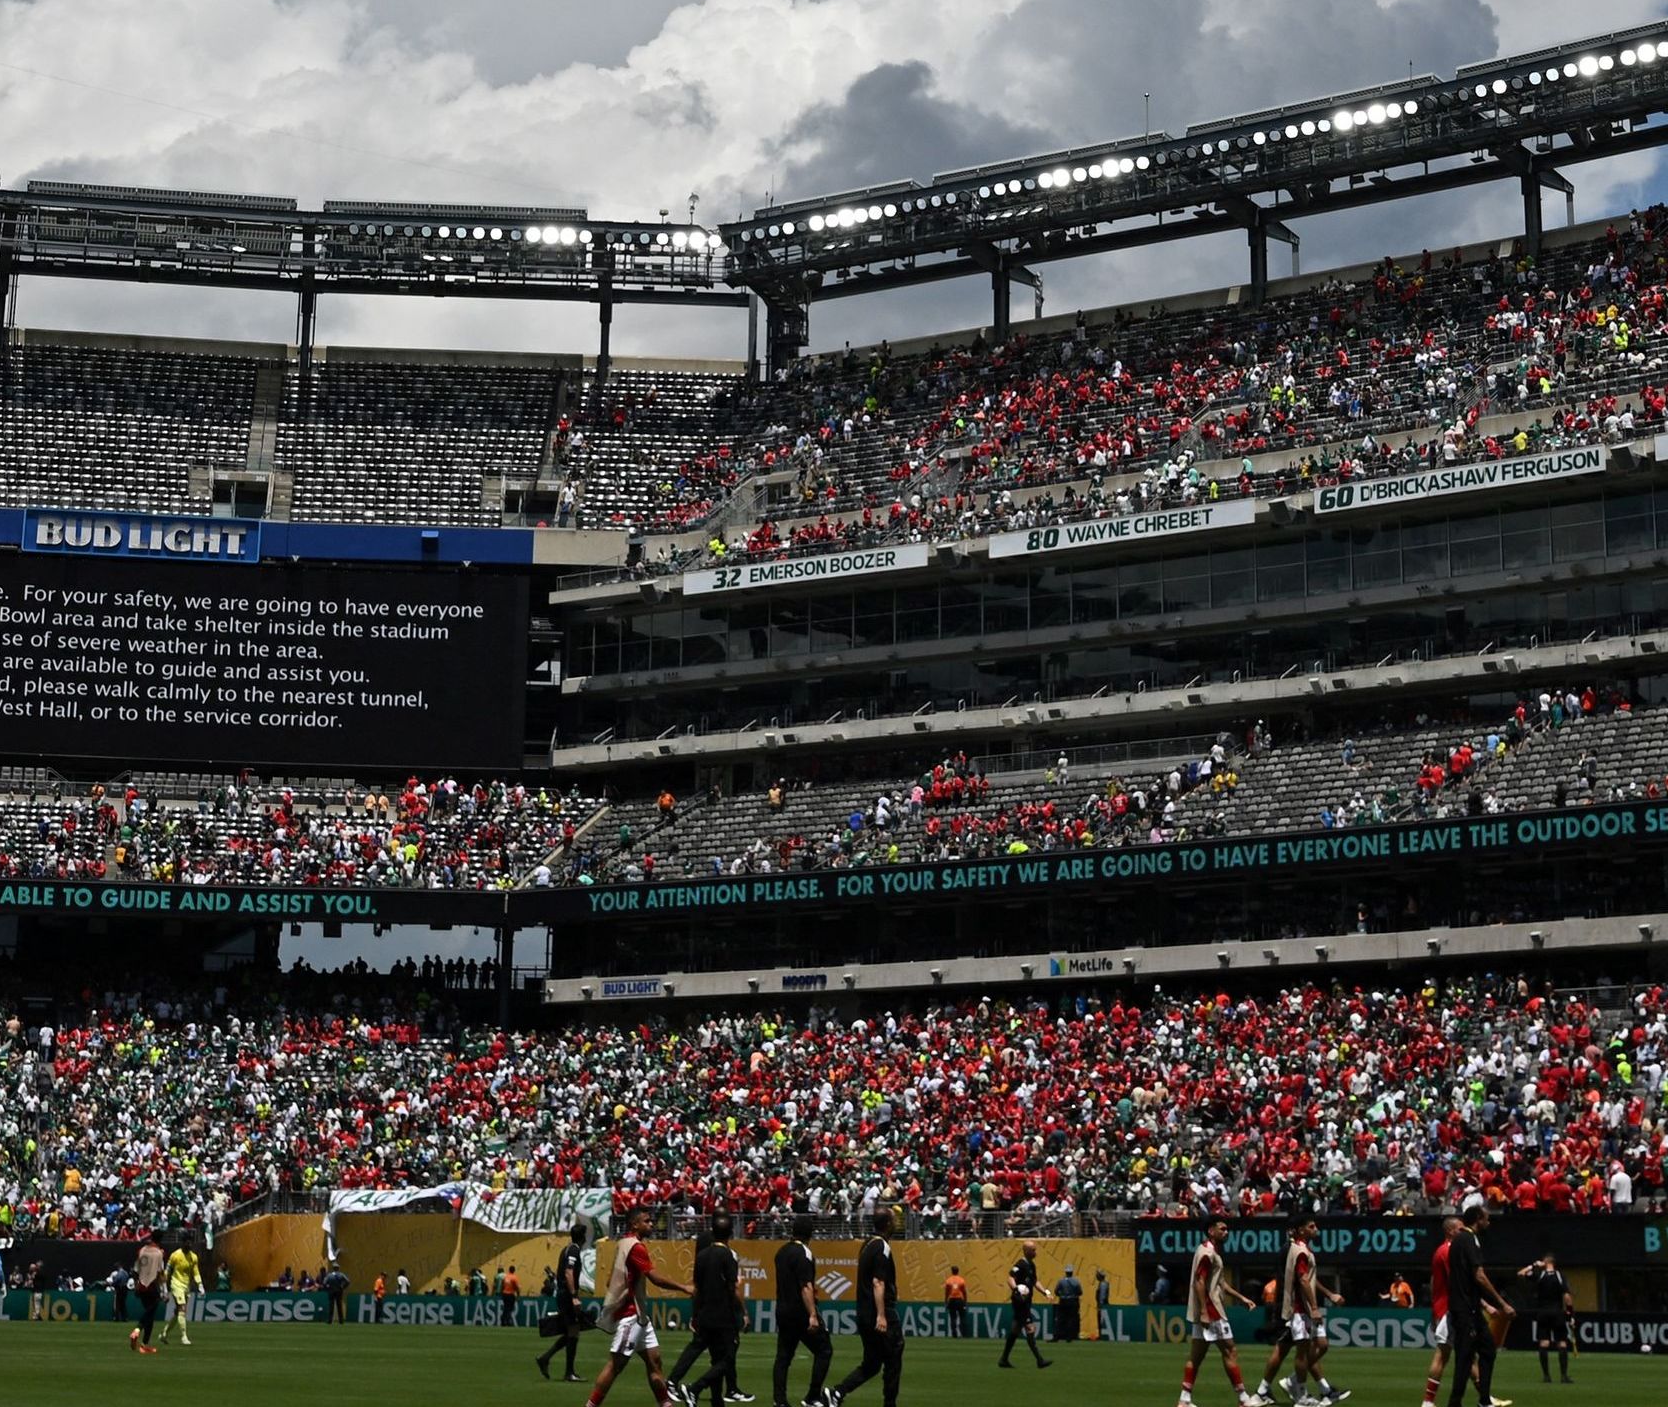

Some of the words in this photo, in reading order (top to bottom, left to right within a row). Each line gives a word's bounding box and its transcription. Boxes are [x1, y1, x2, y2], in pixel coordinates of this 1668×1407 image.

[1318, 485, 1353, 510] 60
[1360, 467, 1496, 502] D'BRICKASHAW
[1501, 450, 1599, 480] FERGUSON
[36, 517, 122, 547] BUD
[128, 523, 245, 554] LIGHT
[1026, 528, 1059, 550] 80
[1066, 515, 1130, 543] WAYNE
[1133, 509, 1213, 533] CHREBET
[712, 569, 741, 588] 32
[749, 557, 827, 583] EMERSON
[830, 551, 896, 574] BOOZER
[24, 585, 56, 601] For
[63, 591, 107, 605] your
[115, 590, 176, 610] safety,
[185, 597, 211, 609] we
[219, 598, 248, 610] are
[256, 597, 311, 616] going
[320, 601, 337, 613] to
[346, 598, 389, 615] have
[397, 604, 483, 620] everyone
[0, 607, 45, 624] Bowl
[52, 613, 94, 626] area
[102, 613, 138, 628] and
[146, 614, 186, 630] take
[195, 613, 265, 633] shelter
[269, 615, 325, 635] inside
[333, 621, 363, 637] the
[371, 623, 448, 639] stadium
[31, 631, 52, 647] of
[58, 636, 120, 650] severe
[128, 637, 207, 654] weather
[214, 644, 230, 655] in
[239, 640, 269, 656] the
[277, 646, 322, 659] area.
[3, 657, 33, 669] are
[41, 656, 127, 673] available
[136, 661, 154, 675] to
[162, 661, 216, 679] guide
[224, 663, 260, 679] and
[268, 668, 322, 681] assist
[329, 671, 369, 685] you.
[24, 677, 87, 696] please
[95, 681, 139, 697] walk
[147, 678, 210, 704] calmly
[218, 688, 236, 701] to
[244, 686, 274, 702] the
[283, 692, 354, 705] nearest
[362, 691, 428, 709] tunnel,
[40, 701, 82, 720] Hall,
[91, 707, 111, 719] or
[119, 707, 138, 720] to
[146, 705, 176, 722] the
[184, 711, 251, 724] service
[259, 711, 342, 727] corridor.
[590, 891, 639, 910] YOUR
[645, 884, 747, 908] ATTENTION
[753, 879, 824, 901] PLEASE.
[837, 875, 874, 895] FOR
[881, 870, 935, 893] YOUR
[942, 865, 1010, 890] SAFETY
[1018, 862, 1048, 882] WE
[1057, 859, 1094, 880] ARE
[1101, 851, 1173, 877] GOING
[1180, 848, 1207, 869] TO
[1214, 844, 1268, 867] HAVE
[1277, 833, 1390, 864] EVERYONE
[1399, 827, 1461, 854] LEAVE
[1469, 822, 1508, 847] THE
[1517, 811, 1635, 843] OUTDOOR
[63, 887, 93, 907] TO
[100, 888, 171, 910] GUIDE
[180, 891, 231, 912] AND
[239, 893, 315, 913] ASSIST
[322, 895, 377, 915] YOU.
[1069, 958, 1113, 972] MetLife
[603, 982, 627, 996] BUD
[628, 981, 660, 994] LIGHT
[1311, 1229, 1352, 1252] CUP
[85, 1295, 97, 1321] 1
[358, 1294, 454, 1324] Hsense
[1579, 1322, 1634, 1344] CLUB
